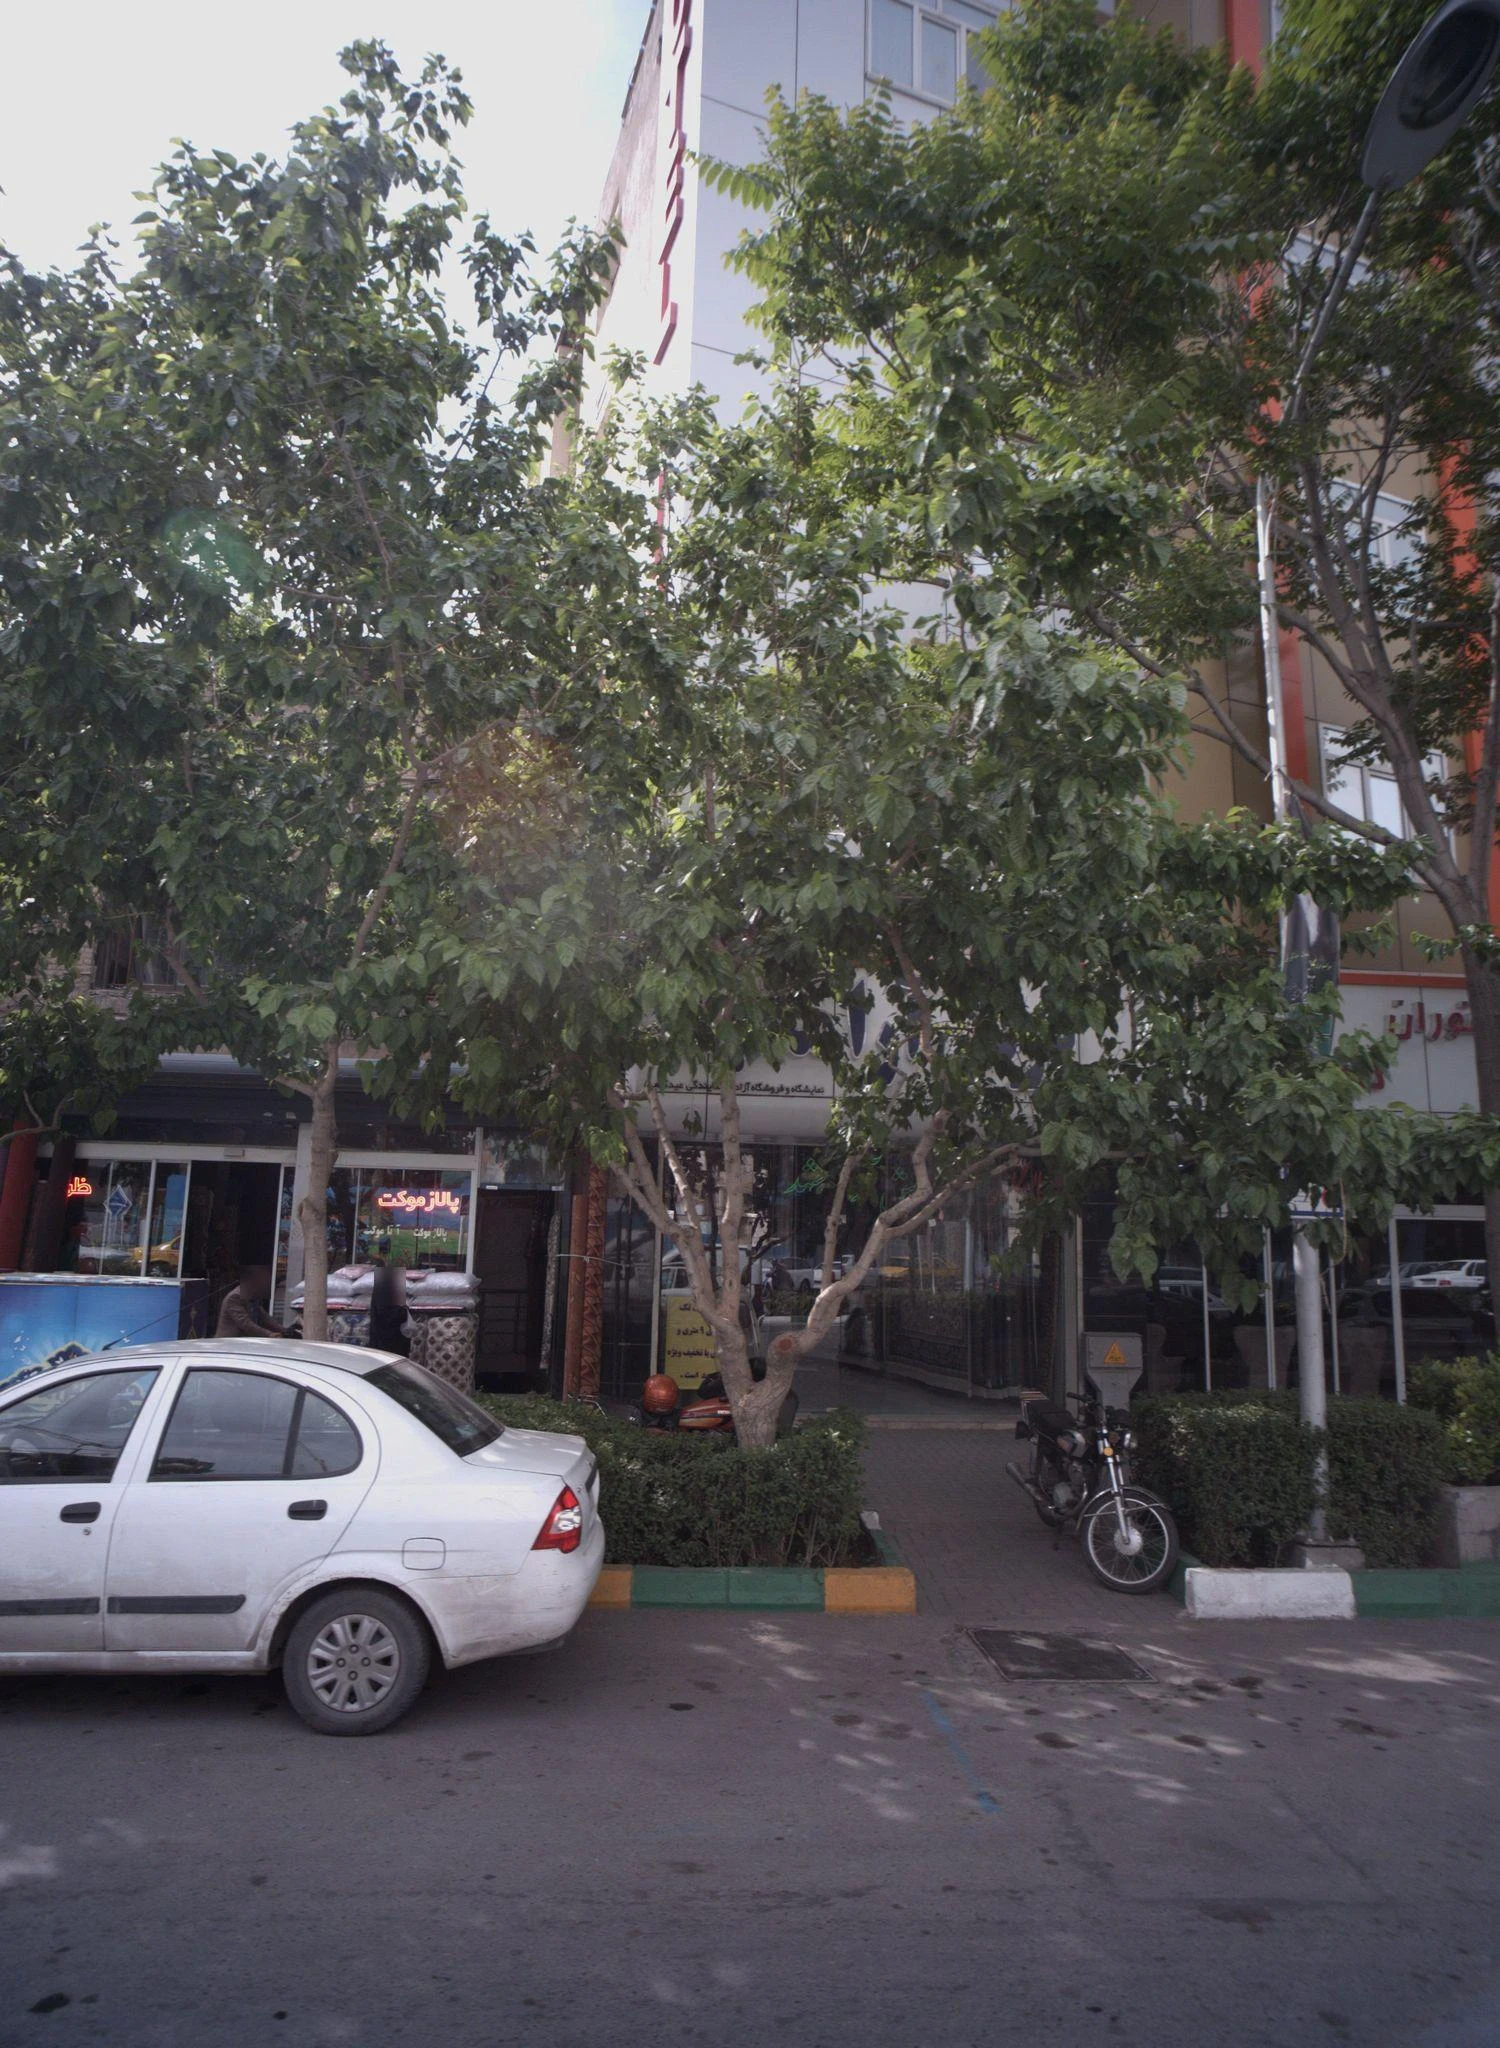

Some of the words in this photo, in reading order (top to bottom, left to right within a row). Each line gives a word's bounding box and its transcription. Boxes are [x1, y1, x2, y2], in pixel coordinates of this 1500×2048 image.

[1383, 1000, 1473, 1041] توران
[685, 1080, 721, 1092] مایندگی
[750, 1082, 784, 1094] فروشگاه
[784, 1086, 790, 1095] و
[790, 1083, 825, 1097] نمایشگاه
[67, 1176, 93, 1197] ظر
[378, 1190, 426, 1212] موکت
[424, 1191, 460, 1214] پالاز
[413, 1228, 431, 1239] موکت
